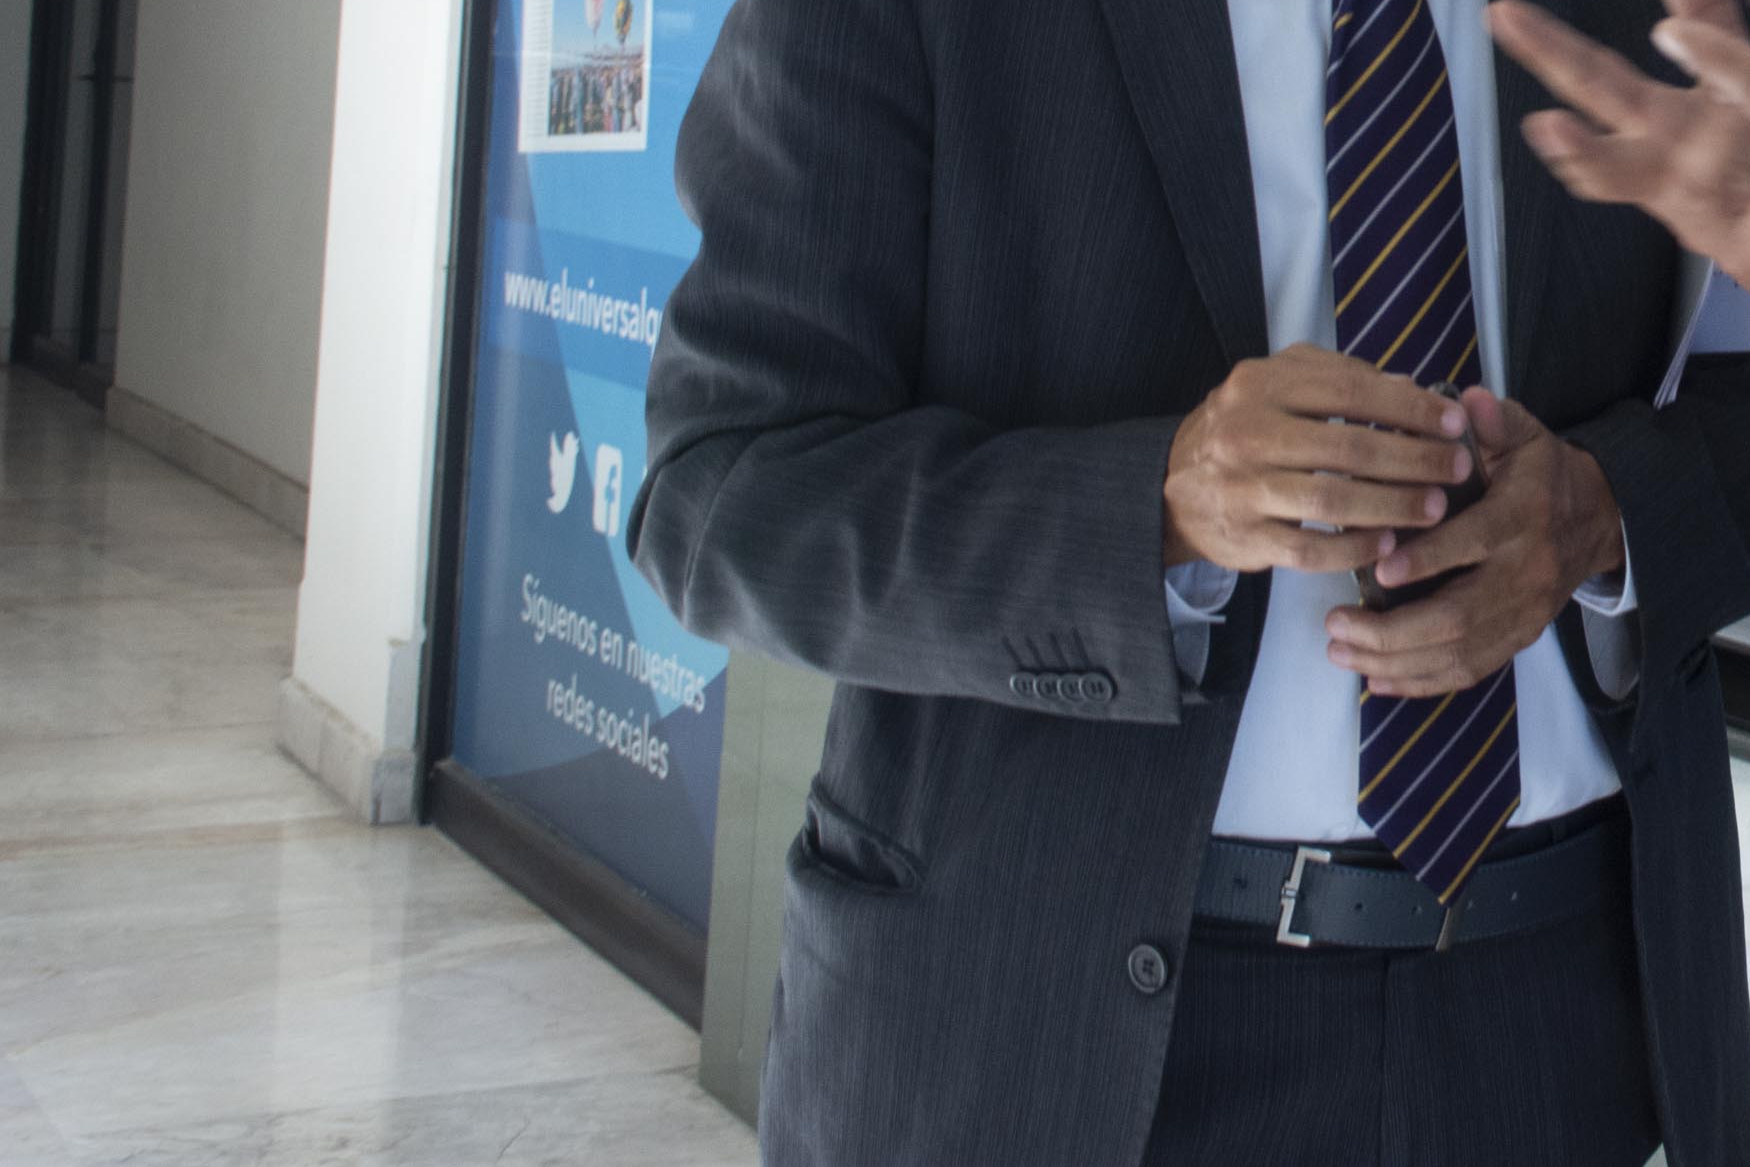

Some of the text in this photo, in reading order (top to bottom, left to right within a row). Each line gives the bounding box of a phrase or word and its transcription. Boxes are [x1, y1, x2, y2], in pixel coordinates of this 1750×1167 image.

[504, 267, 663, 364] www.eluniversalq
[520, 572, 707, 714] Síguenos en nuestras
[546, 672, 670, 780] redes sociales
